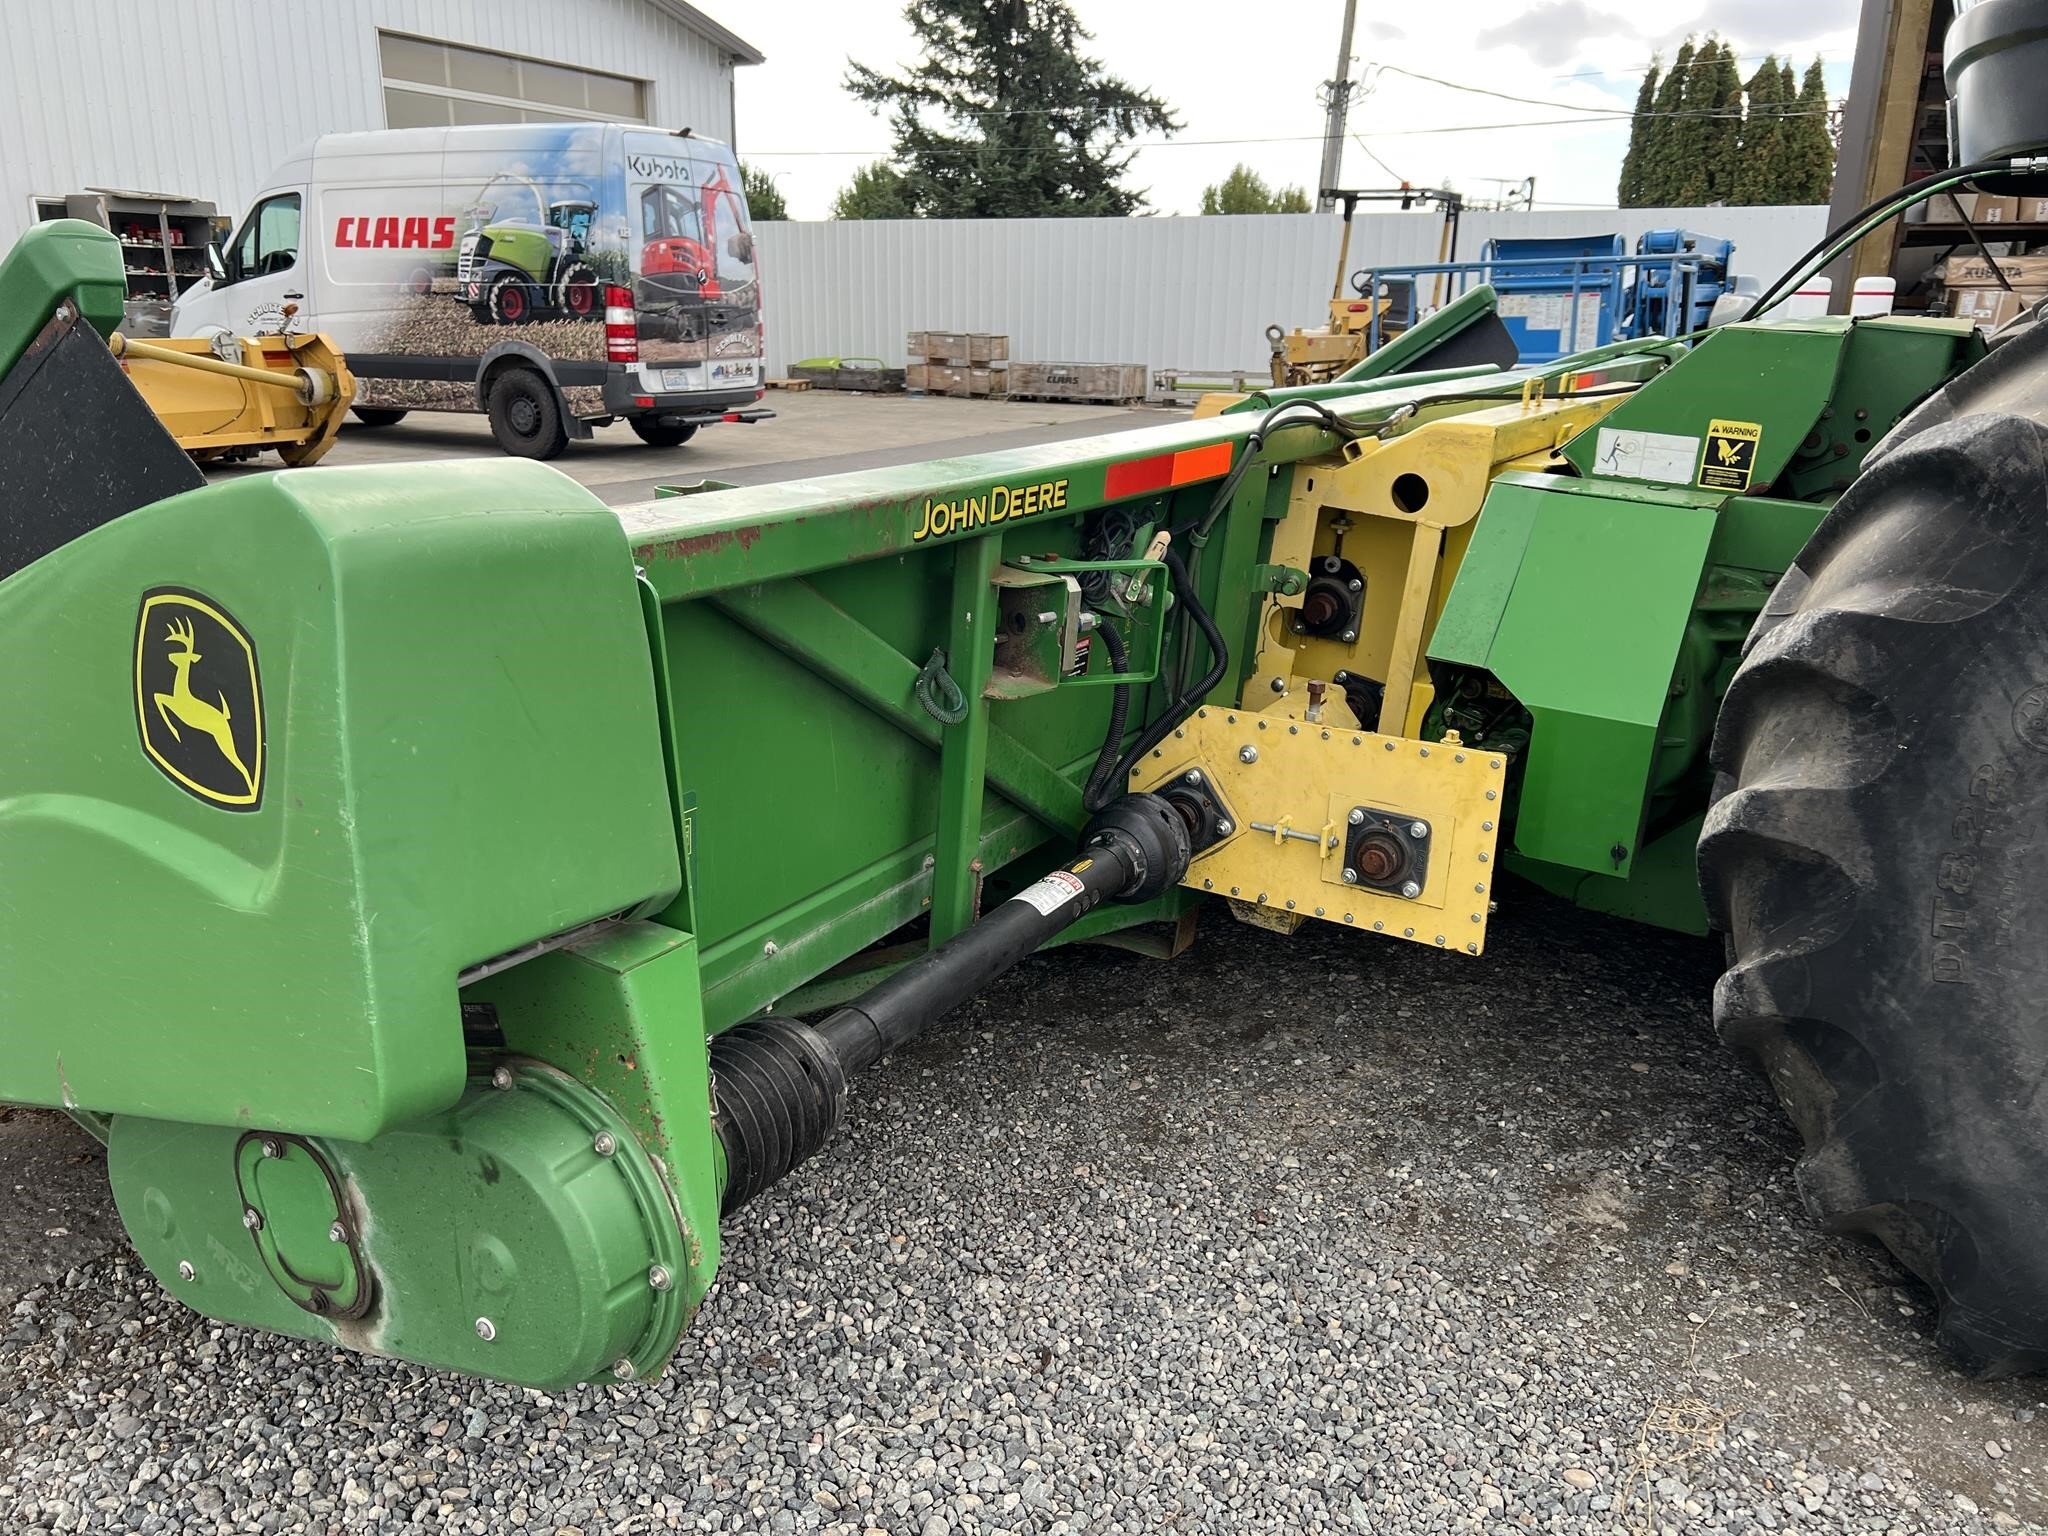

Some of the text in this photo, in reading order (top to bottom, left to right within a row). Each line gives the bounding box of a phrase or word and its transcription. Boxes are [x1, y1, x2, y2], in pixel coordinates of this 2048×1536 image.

[627, 155, 690, 180] Kubota
[335, 217, 456, 248] CLAAS
[1046, 375, 1080, 385] CLAAS
[1721, 424, 1759, 438] WARNING
[912, 479, 1068, 542] JOHN DEERE
